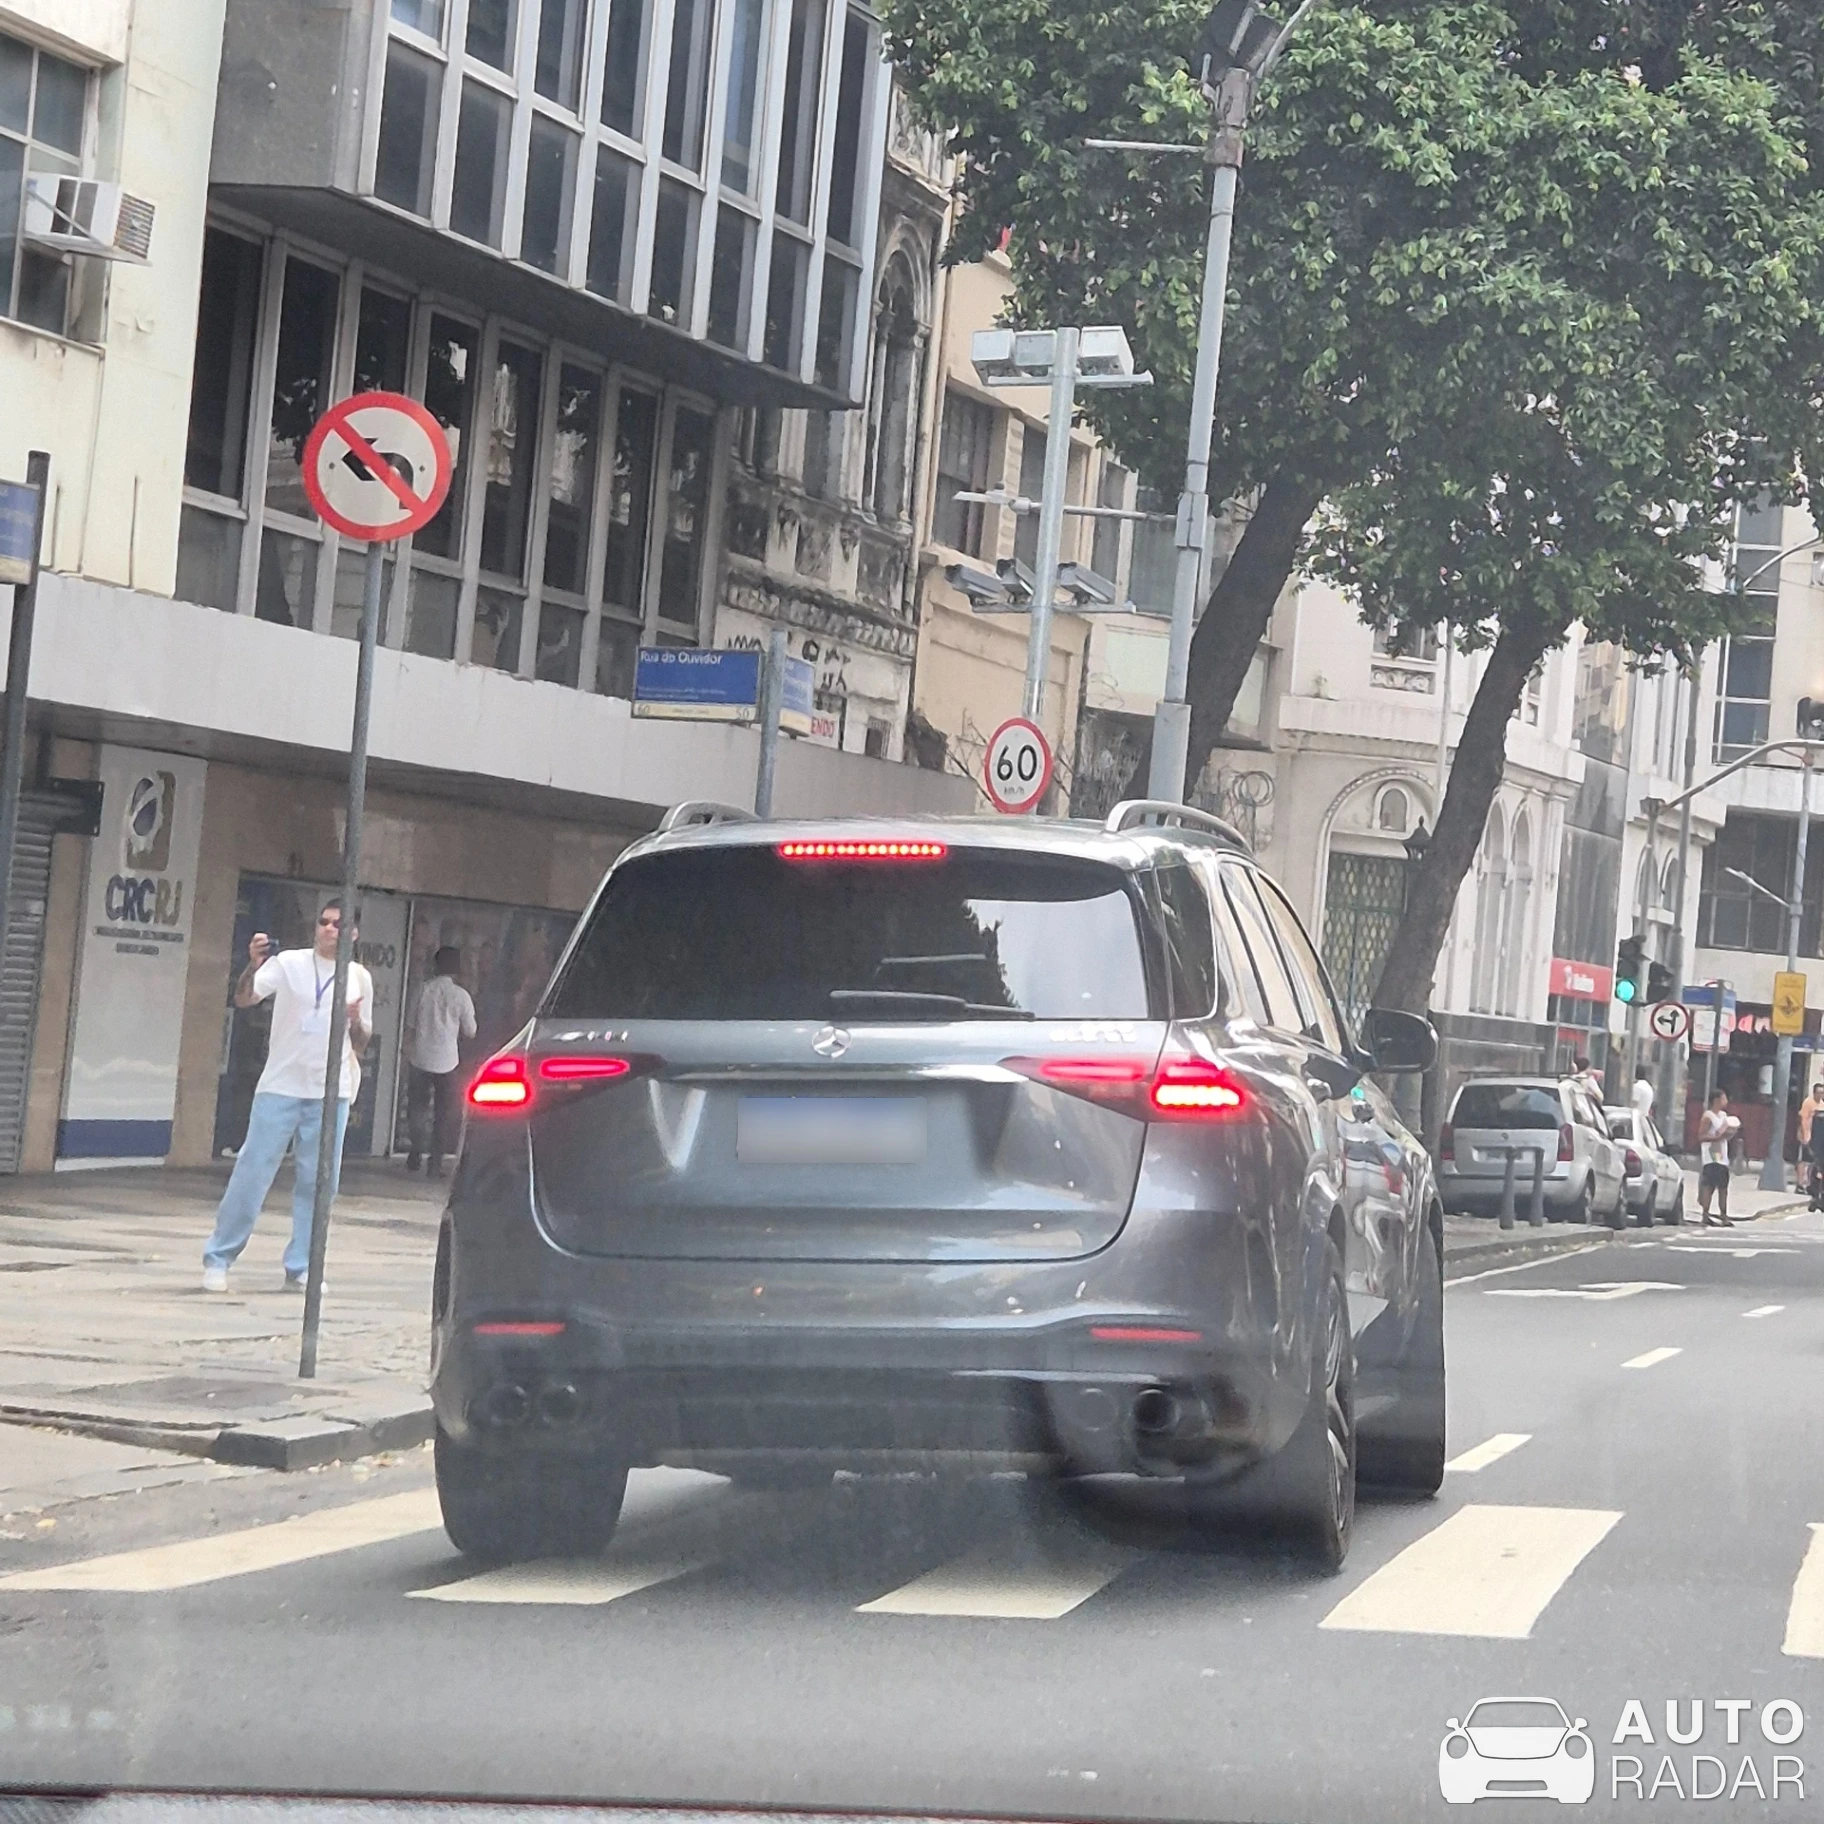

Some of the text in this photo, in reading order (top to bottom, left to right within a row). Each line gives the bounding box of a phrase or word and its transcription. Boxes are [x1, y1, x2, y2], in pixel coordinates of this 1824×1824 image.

[641, 650, 723, 664] Rua do Ouvidor
[997, 744, 1037, 781] 60
[105, 873, 182, 927] CRCRJ
